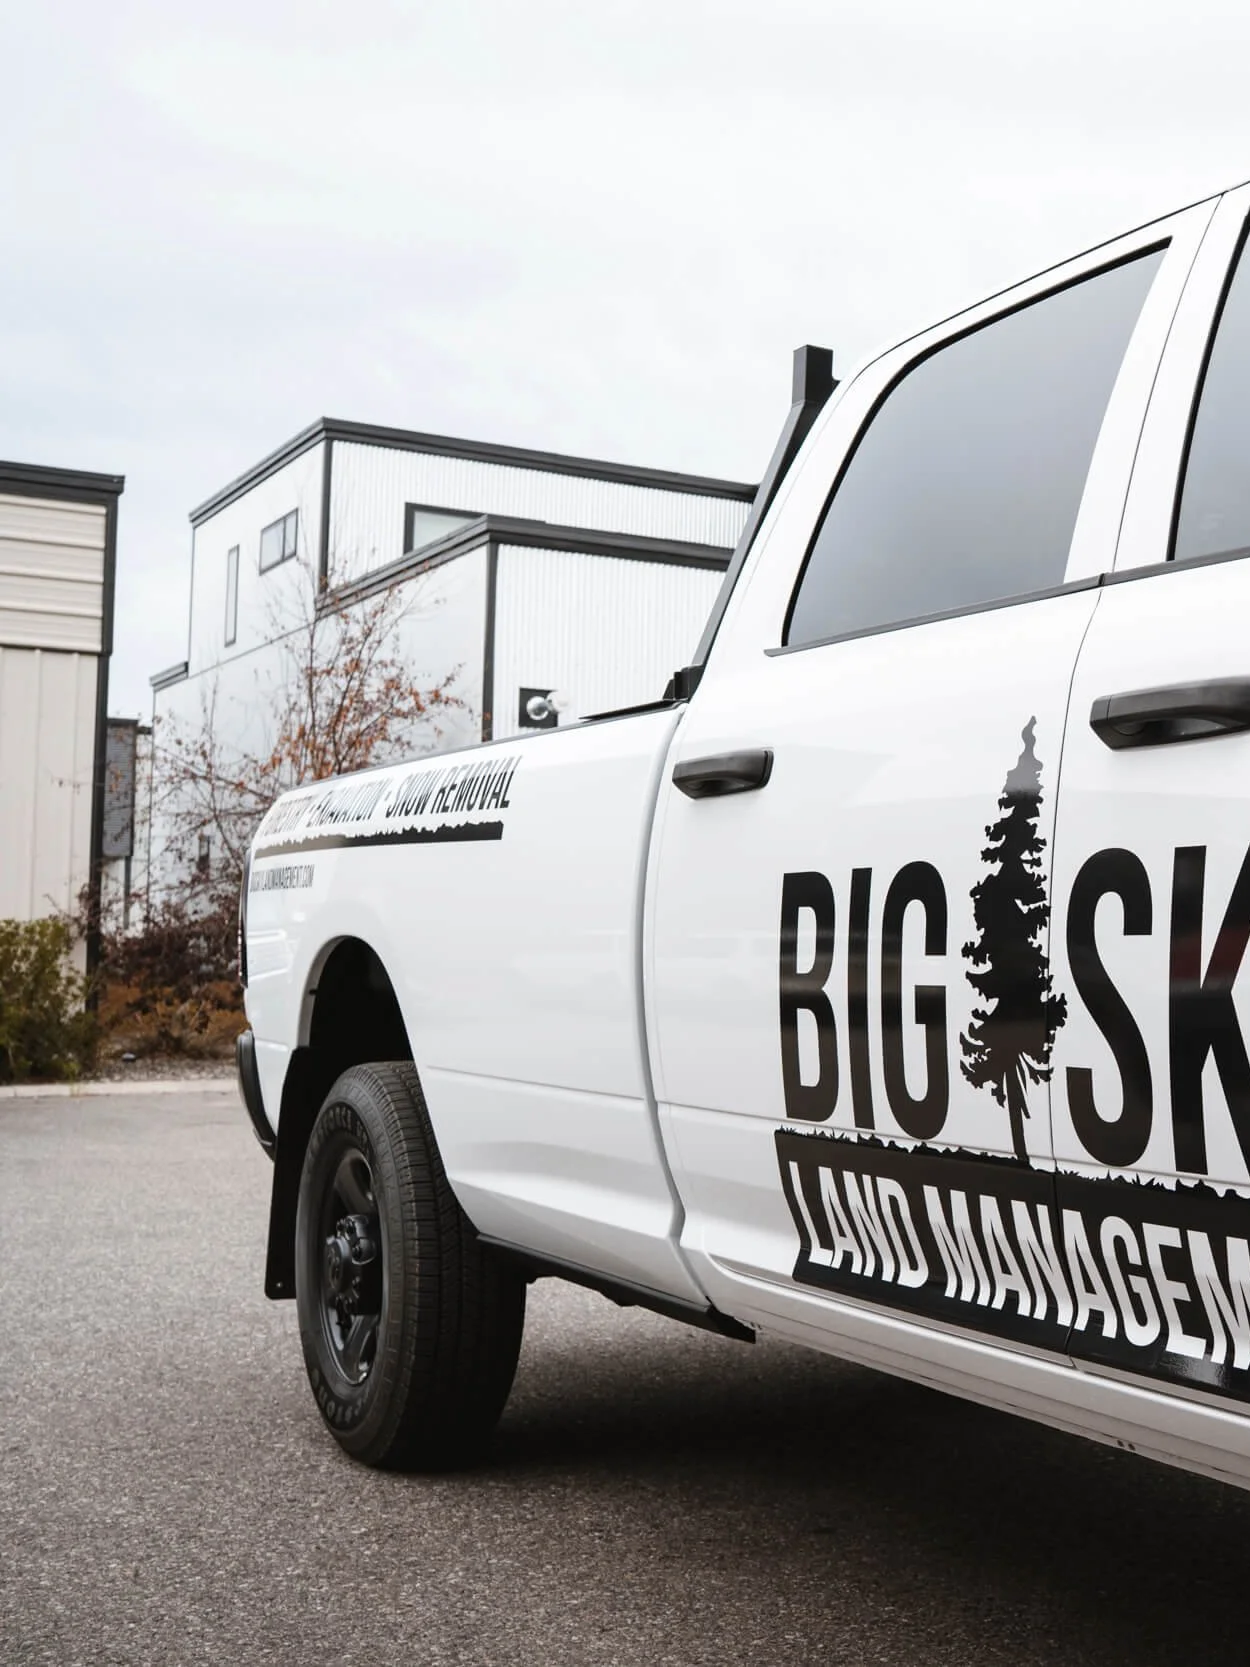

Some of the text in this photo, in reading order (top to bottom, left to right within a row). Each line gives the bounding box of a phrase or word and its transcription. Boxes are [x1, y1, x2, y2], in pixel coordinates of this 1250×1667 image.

[385, 768, 447, 818] SNOW
[430, 755, 522, 813] REMOVAL
[778, 861, 948, 1140] BIG
[788, 1161, 928, 1289] LAND
